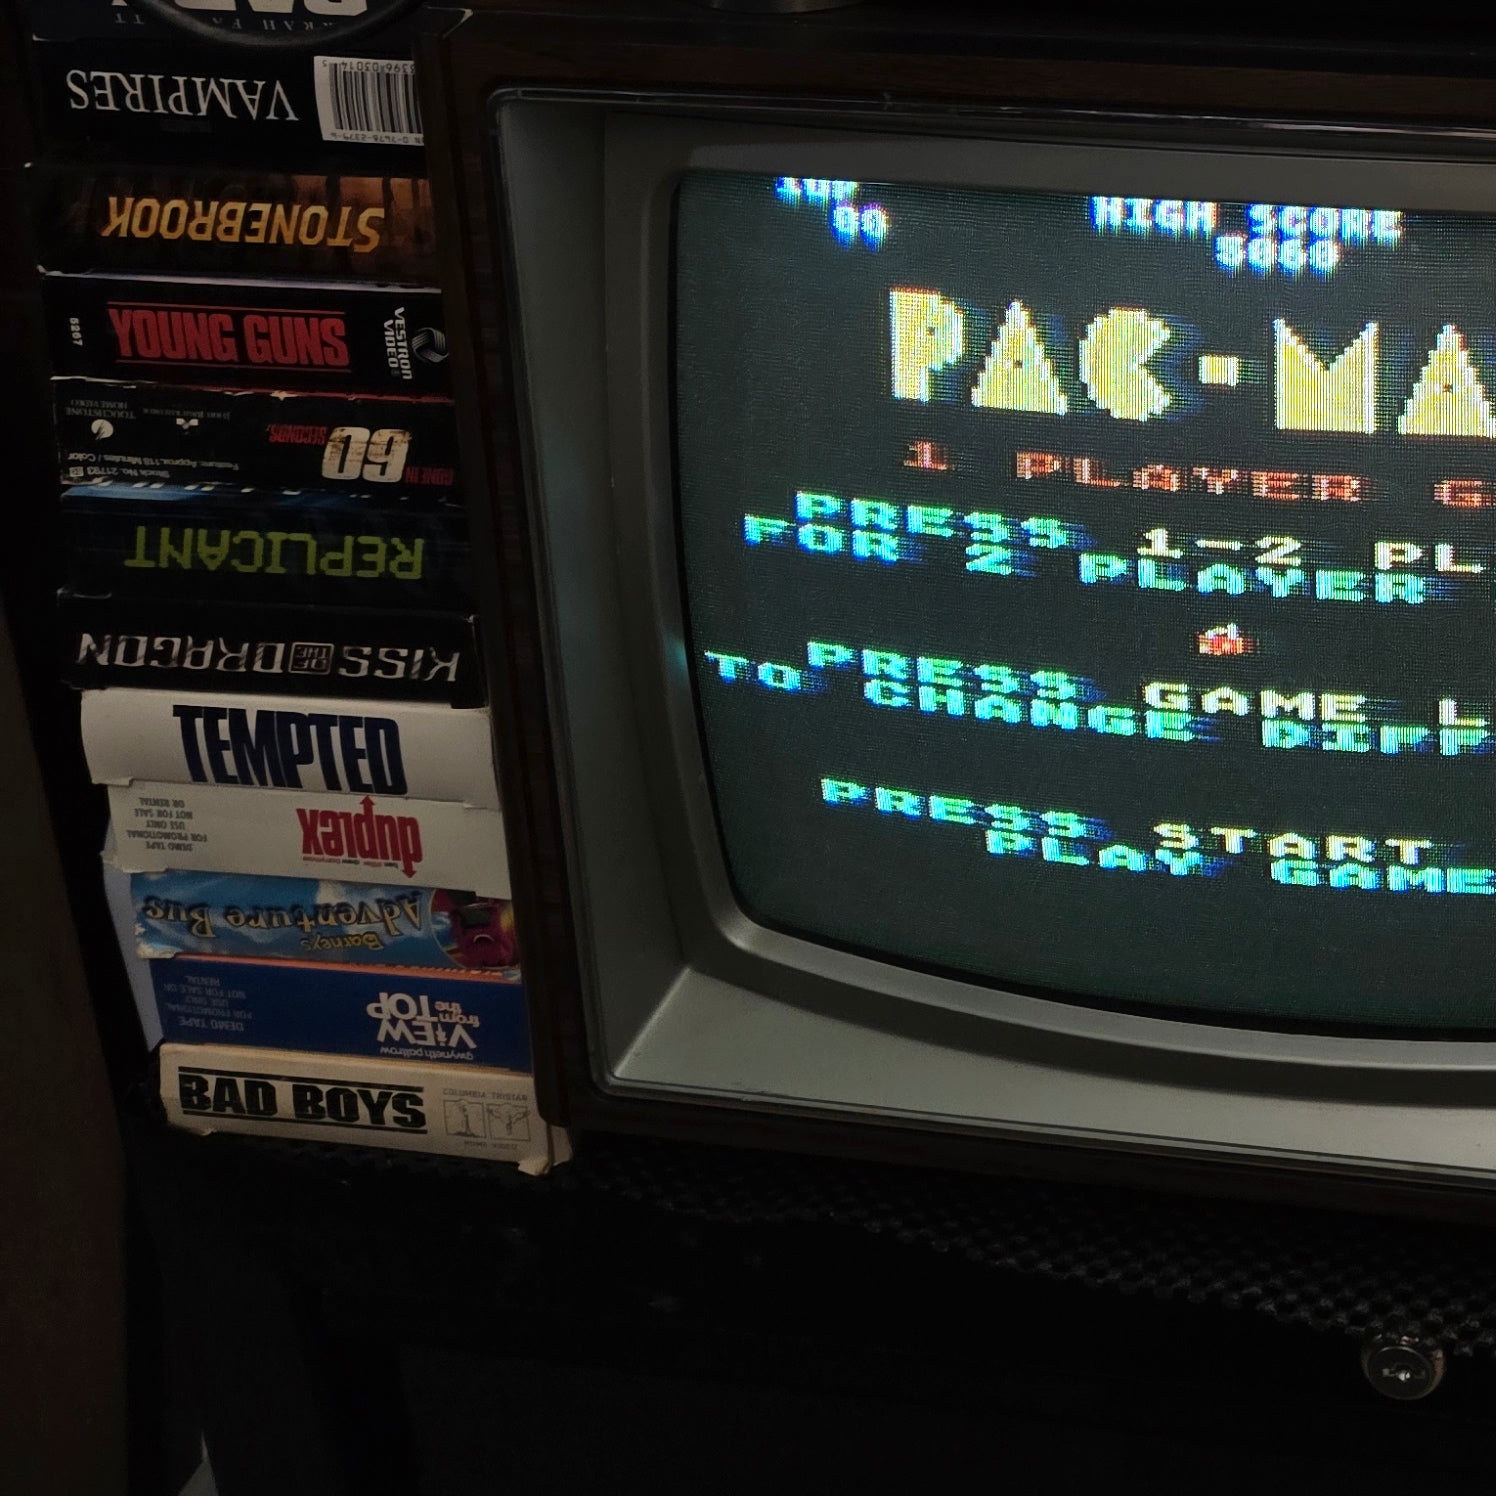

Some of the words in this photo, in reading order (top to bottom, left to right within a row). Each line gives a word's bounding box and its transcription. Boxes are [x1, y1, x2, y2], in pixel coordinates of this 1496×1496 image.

[66, 68, 301, 122] VAMPIRES
[103, 195, 385, 254] STONEBROOK
[1090, 195, 1217, 237] HIGH
[1249, 203, 1405, 247] SCORE
[107, 308, 242, 363] YOUNG
[243, 313, 351, 368] GUNS
[383, 319, 400, 368] VIDEO
[394, 306, 414, 380] VESTRON
[321, 425, 413, 483] 60
[904, 440, 949, 471] 1
[1016, 451, 1363, 504] PLAYER
[123, 524, 425, 580] REPLICANT
[795, 489, 1075, 550] PRESS
[1137, 527, 1303, 567] 1-2
[743, 512, 902, 564] FOR
[964, 543, 1018, 578] 2
[1078, 551, 1426, 604] PLAYER
[74, 631, 287, 674] DRAGON
[337, 644, 462, 683] KISS
[702, 650, 803, 694] TO
[863, 678, 1194, 743] CHANGE
[806, 640, 1078, 702] PRESS
[1140, 680, 1367, 723] GAME
[172, 704, 408, 796] TEMPTED
[297, 794, 424, 879] duplex
[819, 776, 1090, 840] PRESS
[1152, 822, 1432, 867] START
[984, 829, 1203, 877] PLAY
[143, 896, 216, 939] Bus
[226, 896, 424, 937] Adventure
[209, 1018, 245, 1032] DEMO
[365, 991, 438, 1023] TOP
[434, 998, 462, 1016] the
[438, 1010, 480, 1029] from
[178, 1071, 279, 1118] BAD
[292, 1081, 428, 1131] BOYS
[443, 1088, 487, 1099] COLUMBIA
[491, 1091, 529, 1102] TRISTAR
